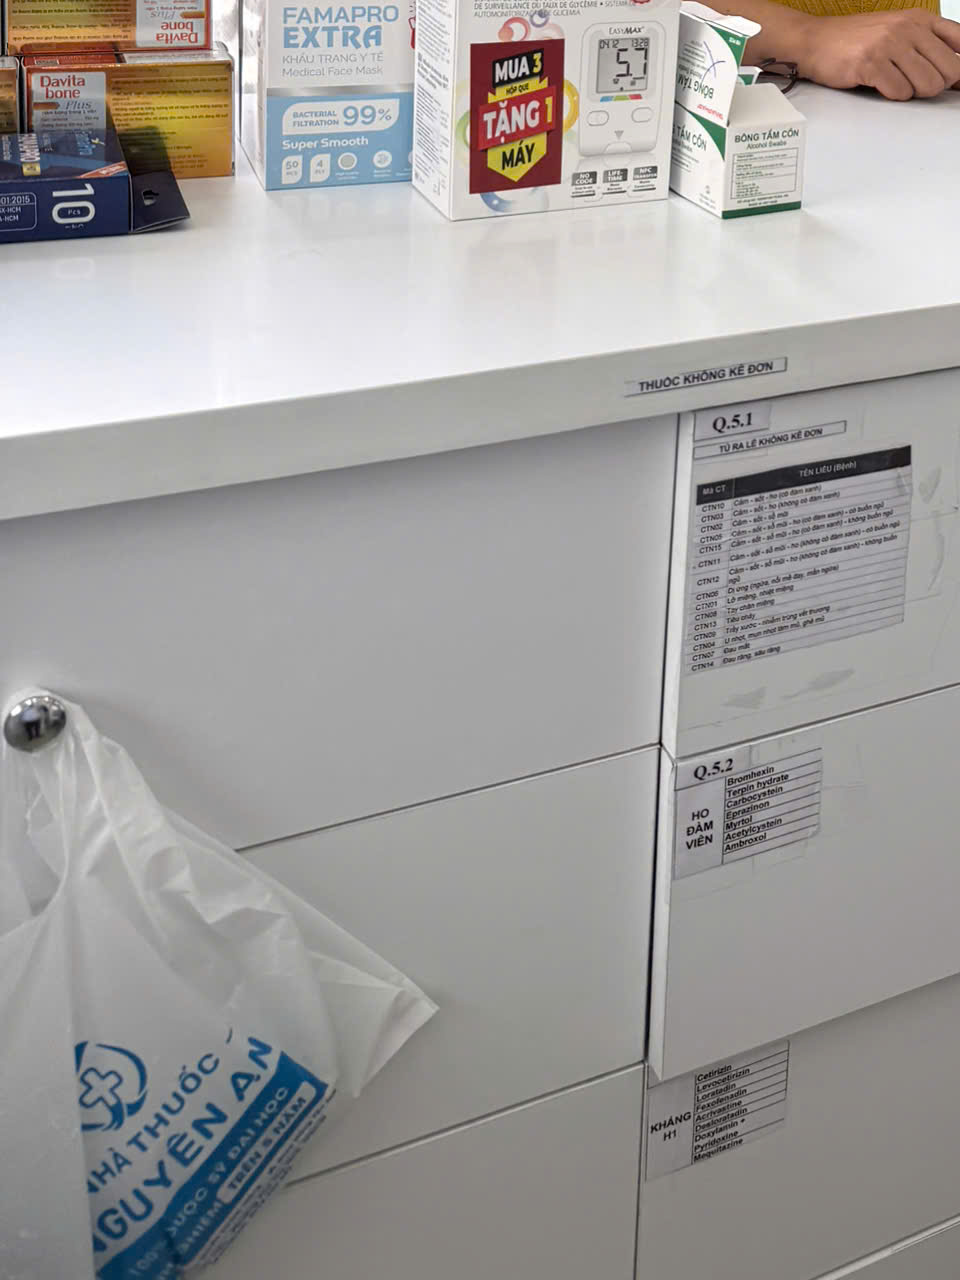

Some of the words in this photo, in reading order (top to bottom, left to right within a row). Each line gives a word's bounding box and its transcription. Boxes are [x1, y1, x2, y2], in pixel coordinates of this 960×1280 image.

[283, 5, 399, 25] FAMAPRO
[161, 22, 194, 33] bone
[284, 25, 382, 49] EXTRA
[155, 33, 198, 44] Davita
[318, 53, 356, 64] TRANG
[495, 57, 530, 83] MUA
[533, 53, 542, 73] 3
[40, 75, 85, 87] Davita
[282, 67, 325, 77] Medical
[328, 67, 353, 76] Face
[356, 66, 383, 75] Mask
[46, 88, 80, 99] bone
[66, 101, 92, 110] Plus
[293, 110, 337, 119] BACTERIAL
[293, 119, 339, 127] FILTRATION
[483, 101, 540, 144] TẶNG
[545, 96, 553, 124] 1
[282, 139, 318, 151] Super
[321, 136, 369, 147] Smooth
[735, 133, 759, 143] BÔNG
[286, 160, 298, 169] 50
[502, 141, 536, 171] MÁY
[52, 183, 95, 224] 10
[683, 368, 726, 385] KHÔNG
[729, 363, 744, 376] KÊ
[748, 361, 773, 374] ĐƠN
[712, 412, 752, 434] Q.5.1
[732, 442, 744, 451] RA
[759, 431, 789, 447] KHÔNG
[693, 758, 733, 780] Q.5.2
[728, 766, 774, 787] Bromhexin
[728, 784, 755, 798] Terpin
[757, 773, 789, 790] hydrate
[727, 786, 783, 808] Carbocystein
[692, 808, 710, 821] HO
[726, 800, 770, 820] Eprazinon
[686, 820, 713, 836] ĐÀM
[725, 818, 782, 841] Acetylcystein
[726, 816, 753, 831] Myrtol
[686, 834, 713, 850] VIÊN
[724, 833, 767, 852] Ambroxol
[697, 1068, 750, 1092] Levocetirizin
[698, 1064, 732, 1082] Cetirizin
[126, 1052, 220, 1152] THUỐC
[696, 1088, 747, 1112] Fexofenadin
[697, 1083, 736, 1102] Loratadin
[272, 1096, 307, 1136] NĂM
[695, 1107, 747, 1133] Desloratadin
[696, 1100, 742, 1122] Acrivastine
[651, 1111, 692, 1133] KHÁNG
[695, 1121, 738, 1142] Doxylamin
[663, 1130, 677, 1141] H1
[694, 1130, 739, 1152] Pyridoxine
[694, 1138, 743, 1162] Mequitazine
